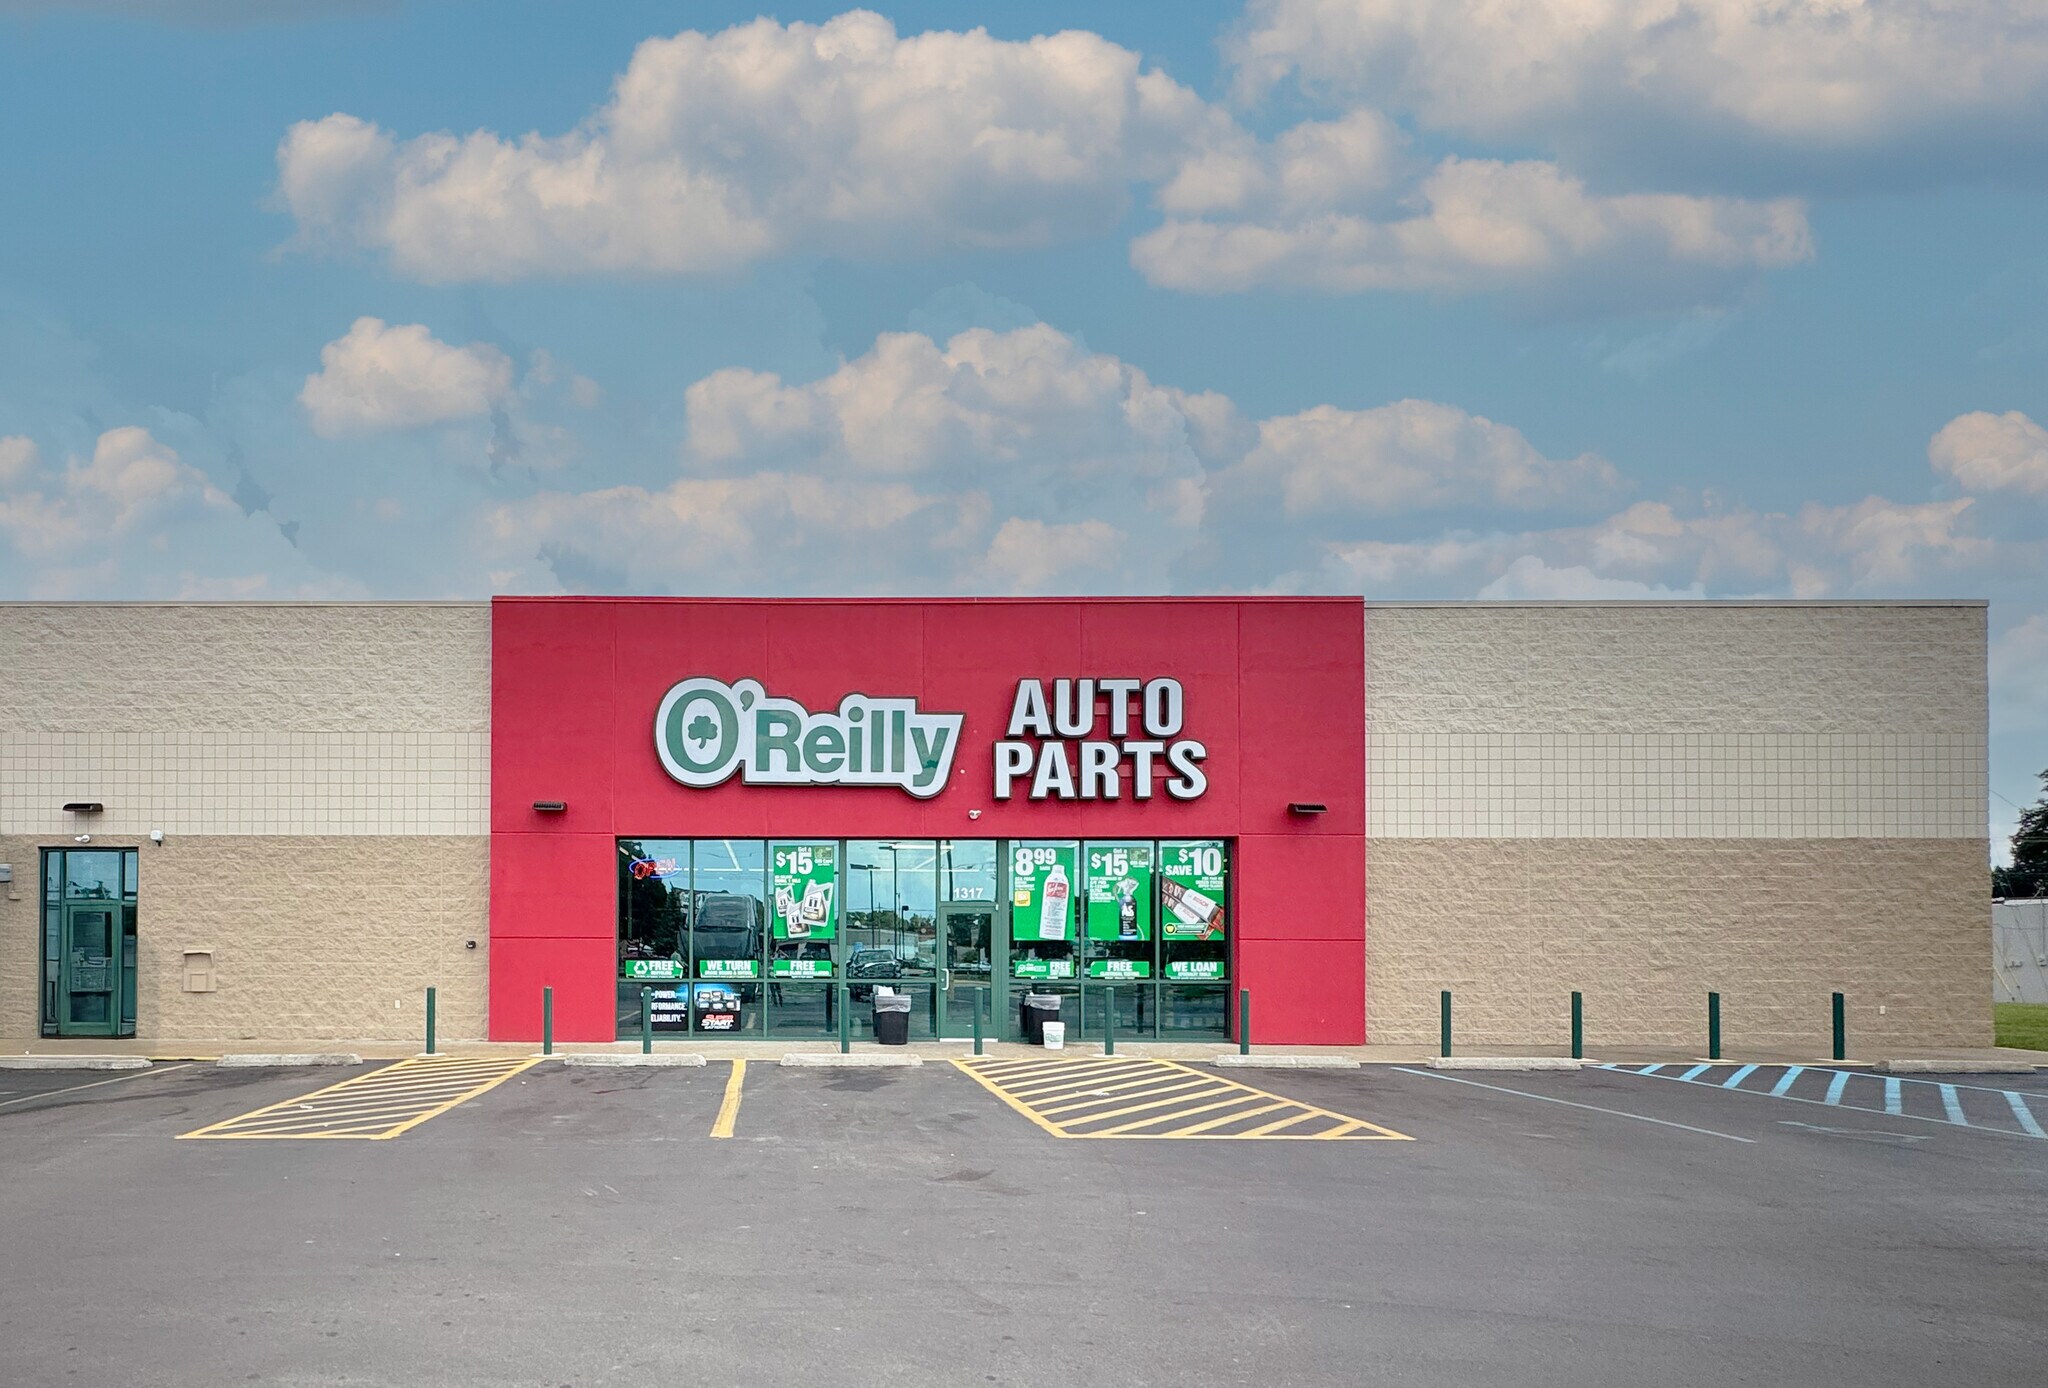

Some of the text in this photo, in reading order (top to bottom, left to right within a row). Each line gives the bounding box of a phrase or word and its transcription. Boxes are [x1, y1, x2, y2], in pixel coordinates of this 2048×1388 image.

[1005, 677, 1184, 738] AUTO
[664, 687, 952, 788] O'Reilly
[993, 740, 1210, 800] PARTS
[776, 851, 814, 875] $15
[1091, 853, 1129, 877] $15
[1178, 848, 1222, 876] $10
[634, 857, 677, 880] OPEN
[1165, 864, 1193, 876] SAVE
[954, 887, 984, 899] 1317
[649, 960, 674, 971] FREE
[706, 960, 752, 971] WE TURN
[790, 960, 816, 971] FREE
[1049, 961, 1071, 971] FREE
[1107, 961, 1133, 972] FREE
[1171, 961, 1218, 972] WE LOAN
[655, 990, 677, 999] POWER.
[651, 1001, 688, 1011] RFORMANCE.
[650, 1013, 682, 1022] ELIABILITY.
[701, 1019, 735, 1027] START
